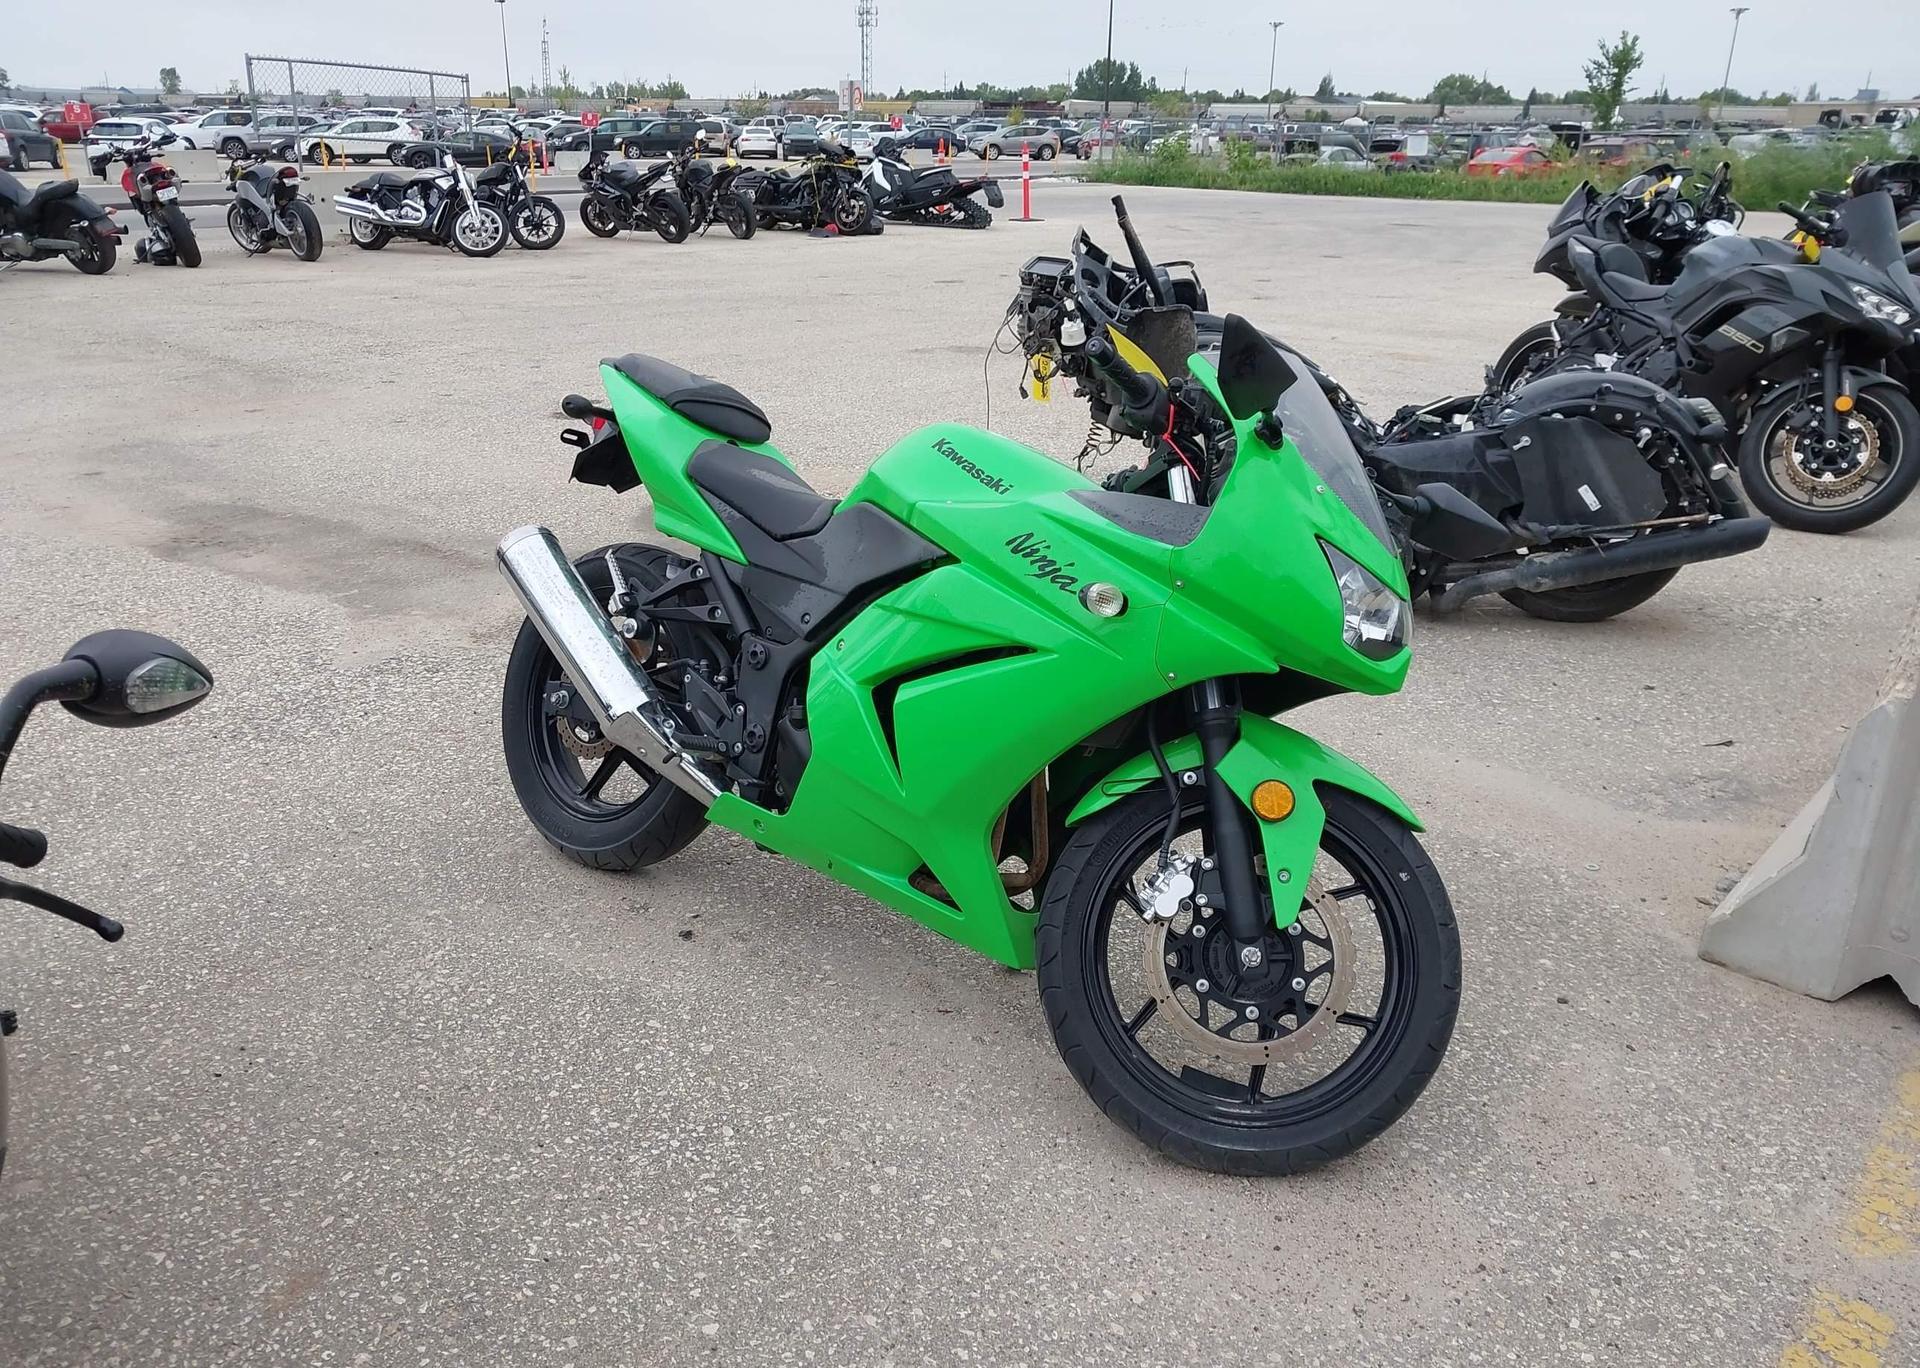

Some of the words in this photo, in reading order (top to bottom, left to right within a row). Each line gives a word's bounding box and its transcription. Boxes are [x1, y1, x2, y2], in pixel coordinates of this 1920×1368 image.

[1718, 324, 1765, 354] 650
[931, 437, 1015, 496] Kawasaki
[1005, 532, 1079, 595] Ninja
